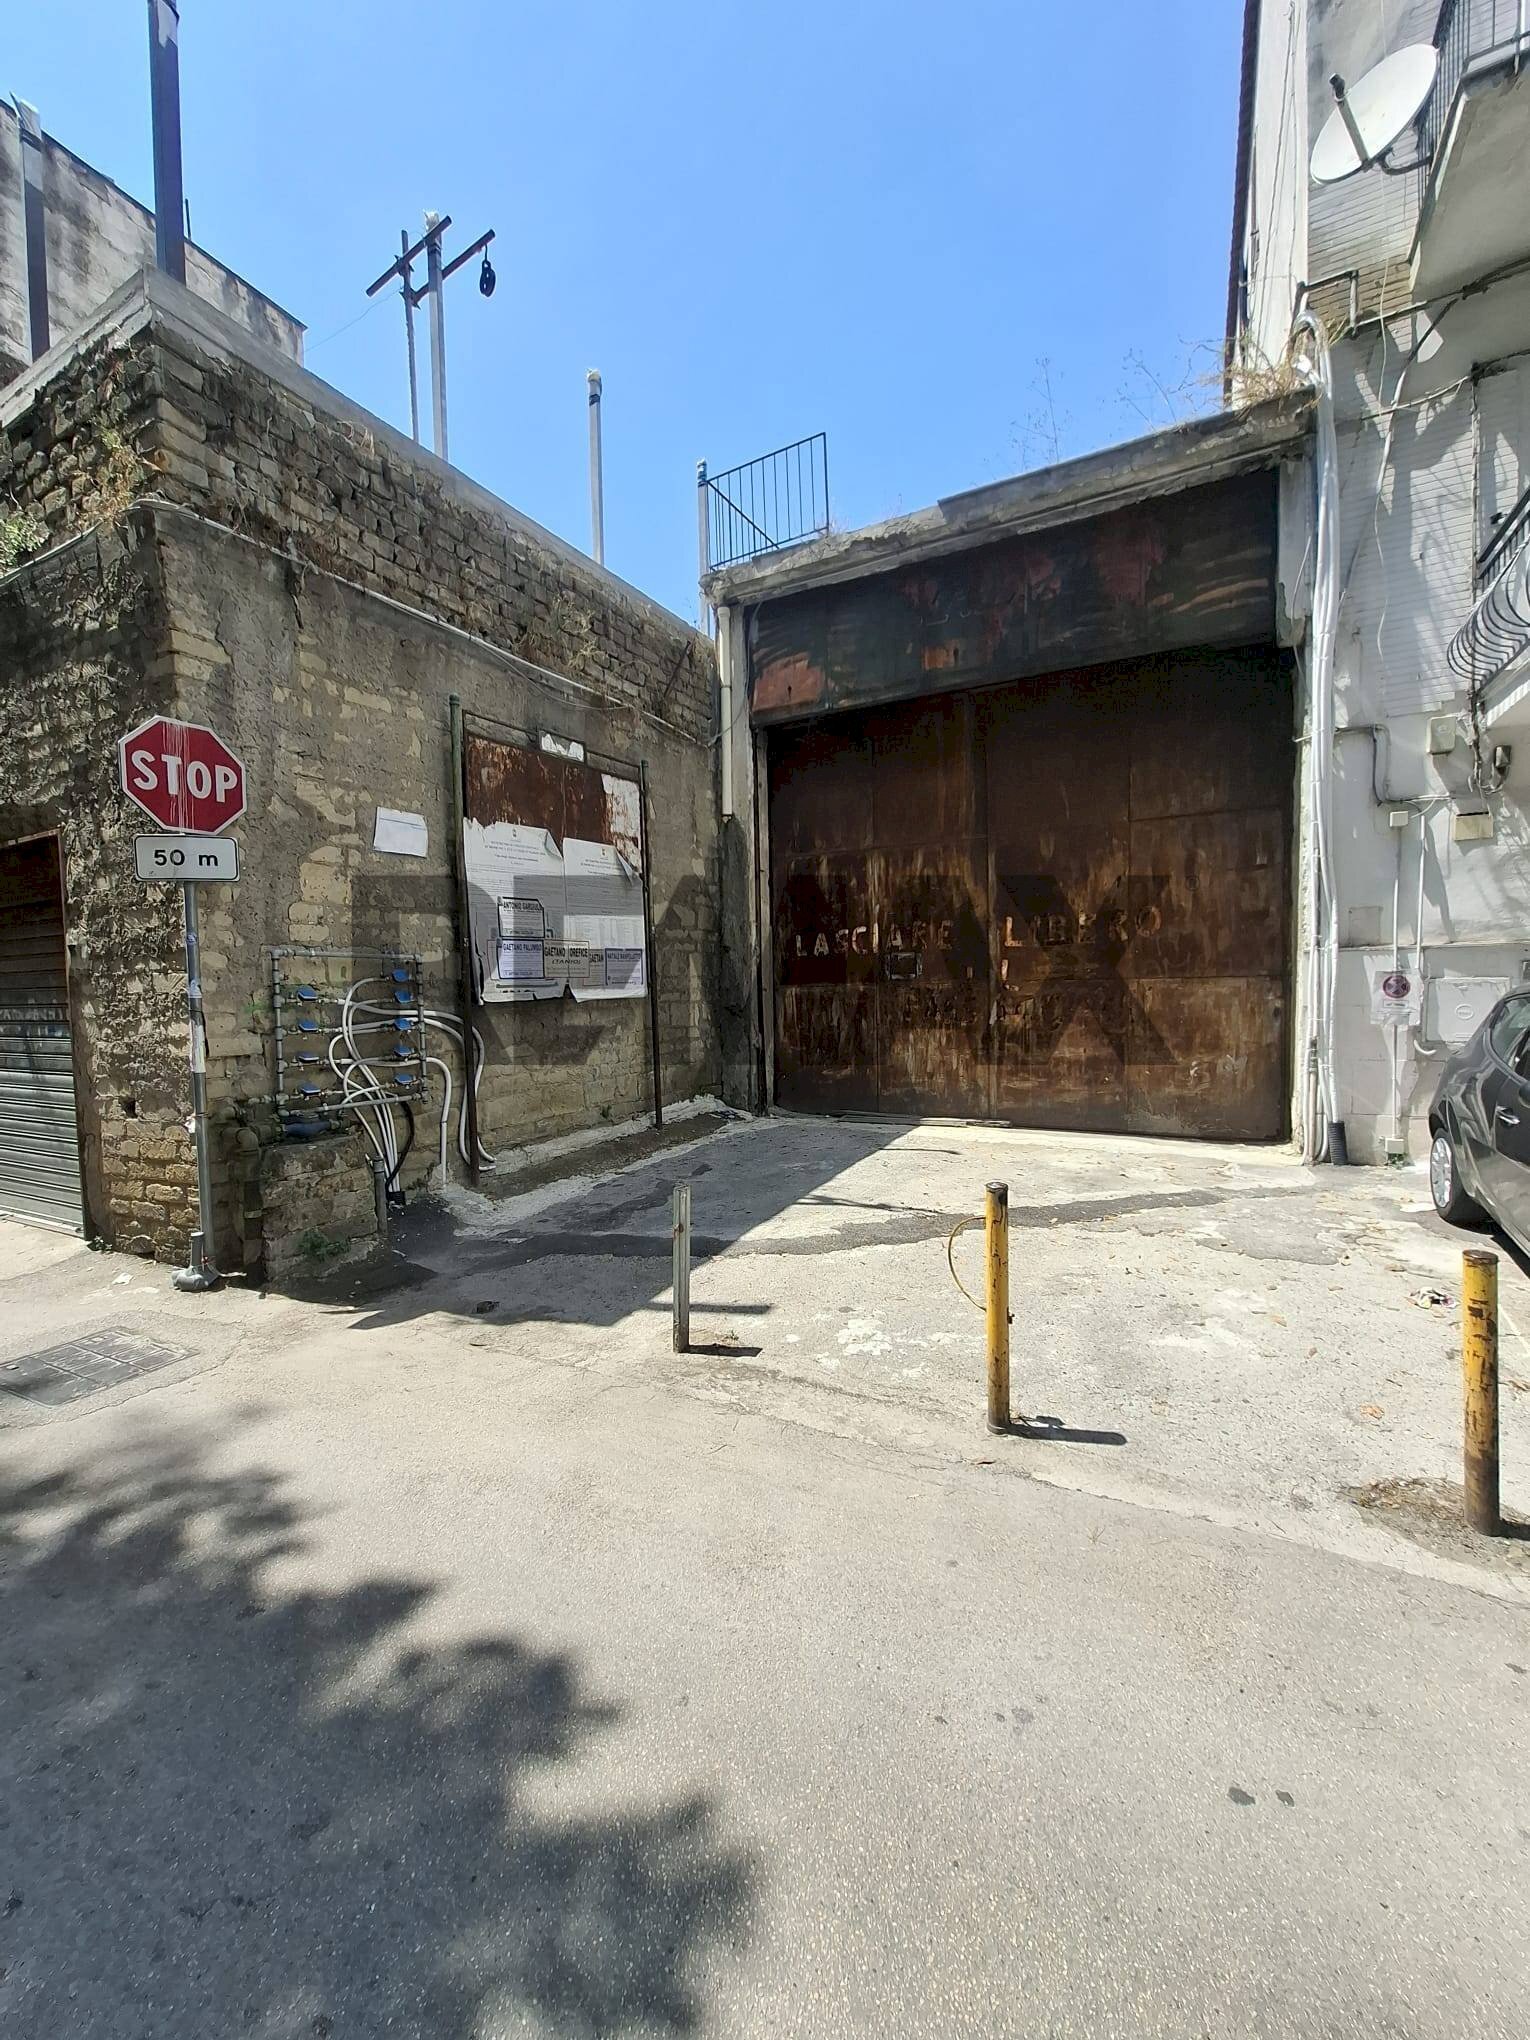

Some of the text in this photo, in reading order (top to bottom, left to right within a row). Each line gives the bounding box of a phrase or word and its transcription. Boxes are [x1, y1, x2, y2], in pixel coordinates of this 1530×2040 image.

[131, 749, 238, 803] STOP
[154, 849, 219, 867] 50 m
[795, 905, 1162, 957] LASCIARE LIBERO
[503, 943, 522, 951] GAETANO
[545, 946, 588, 958] GAETANO OREFICE
